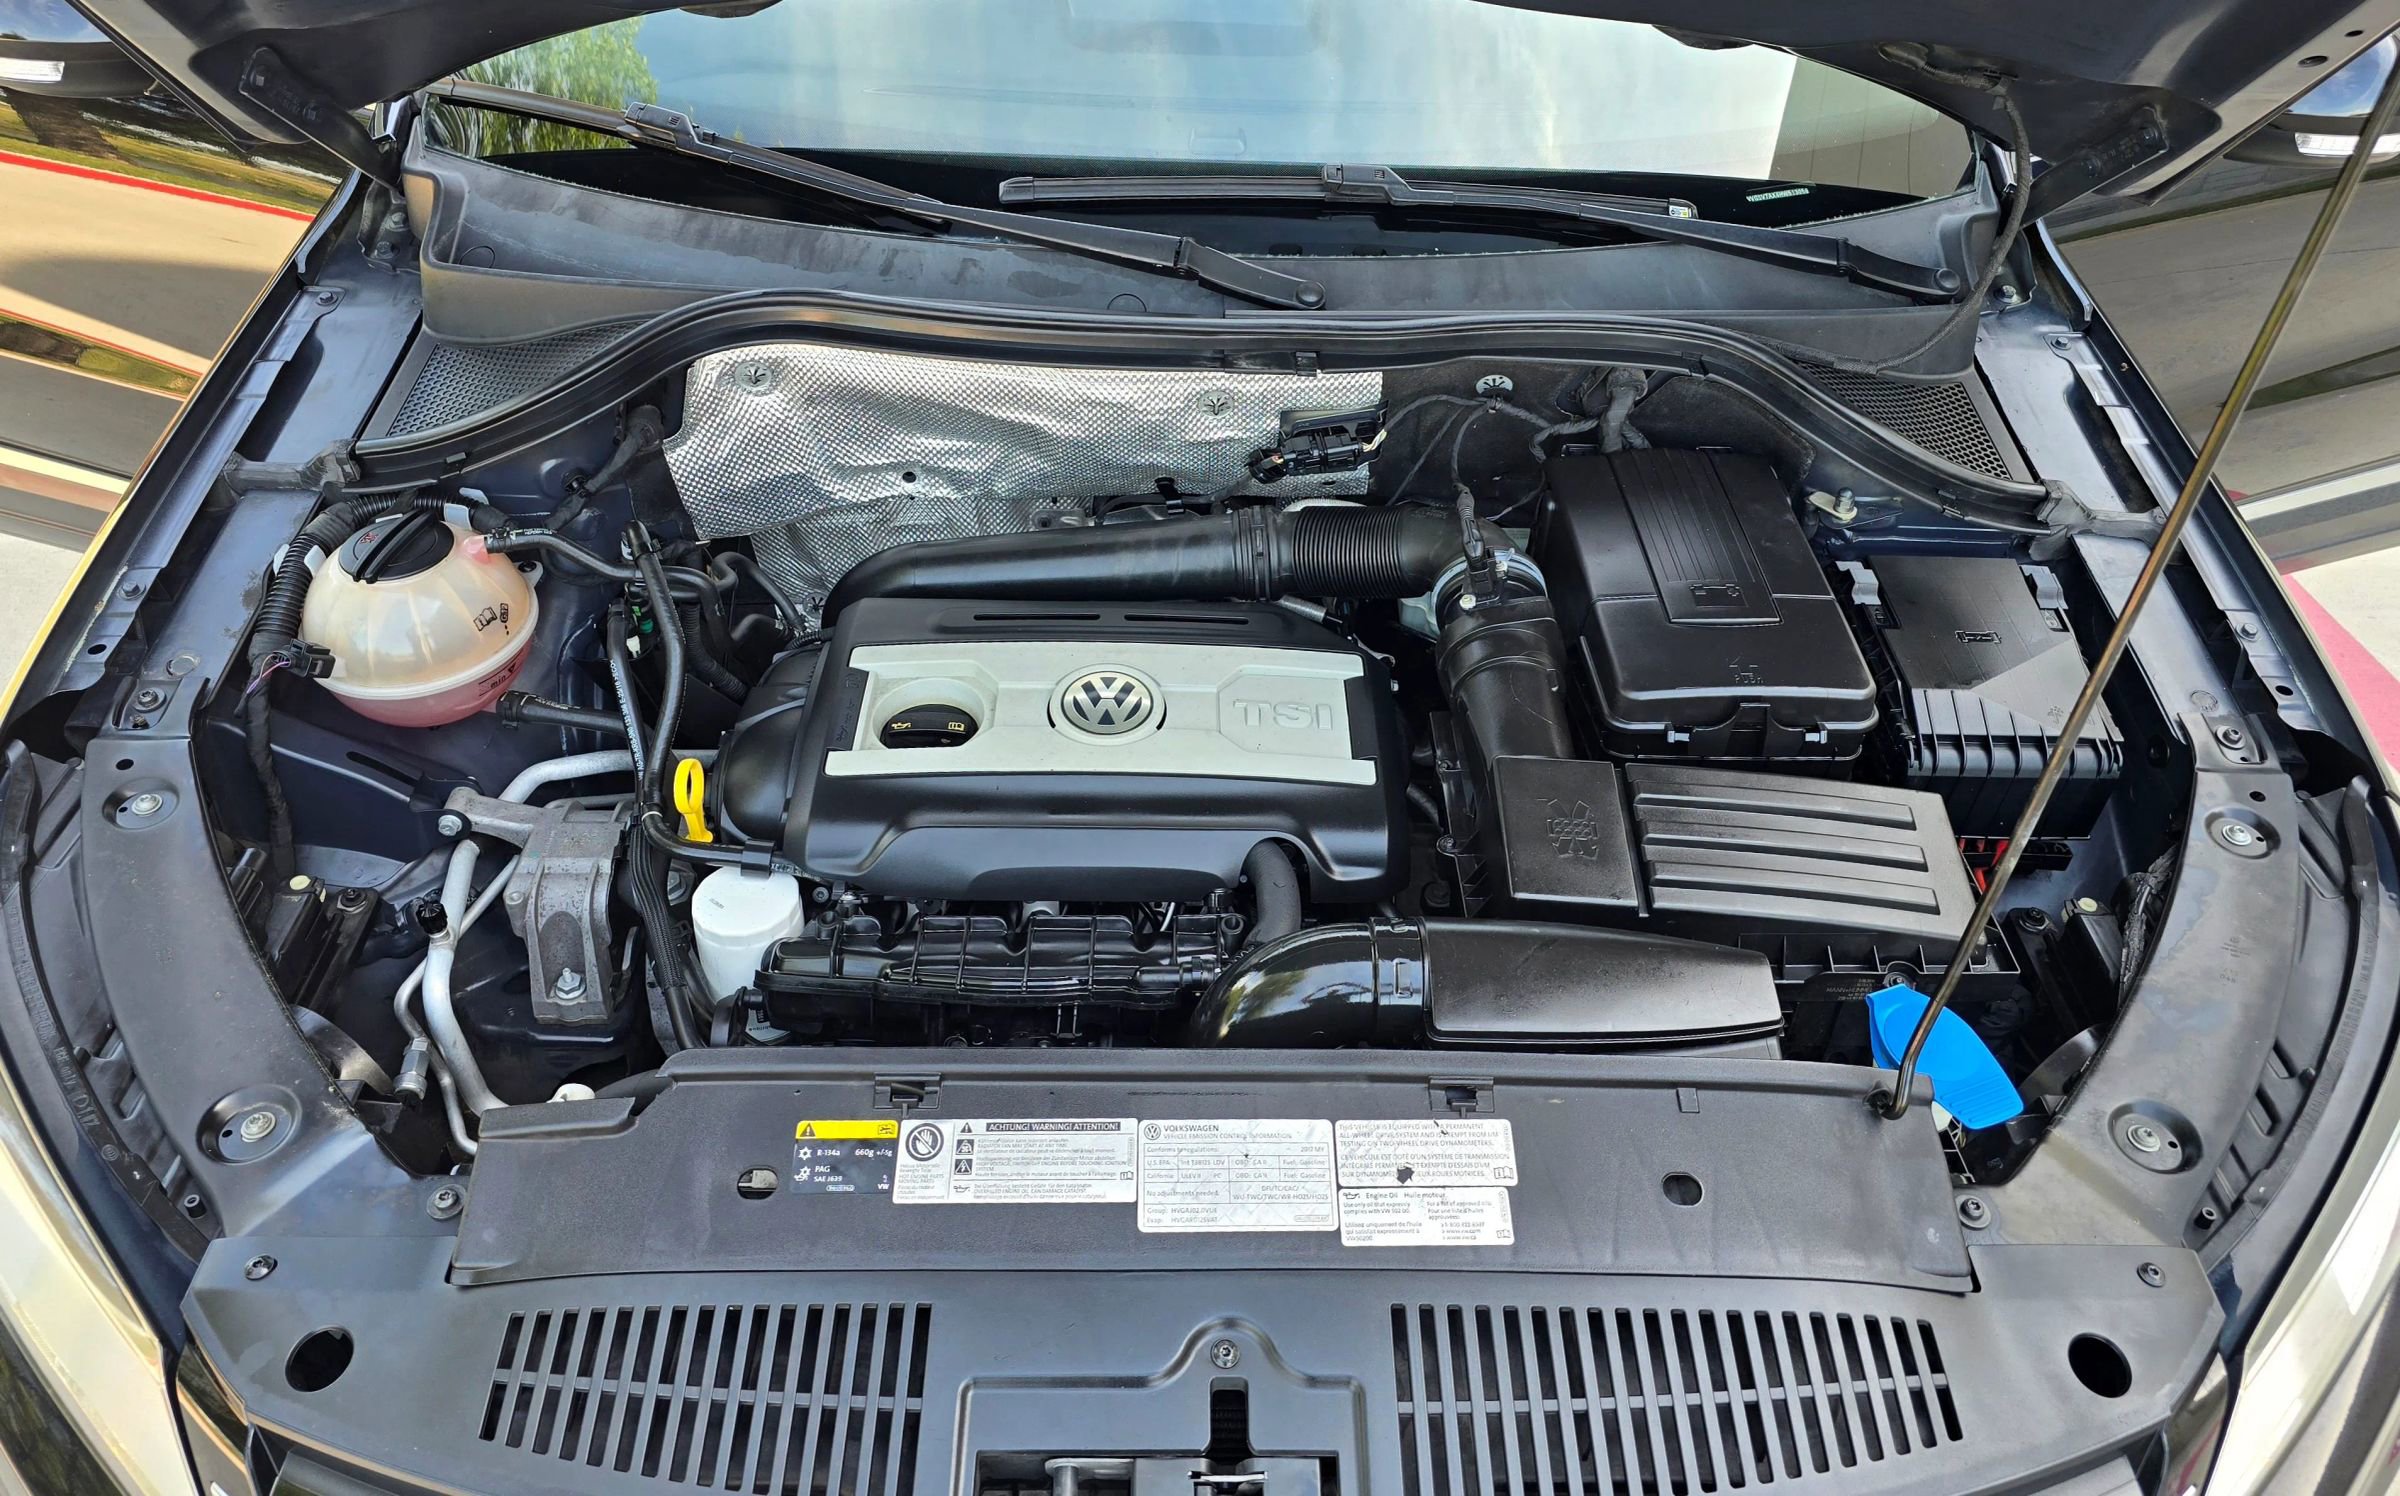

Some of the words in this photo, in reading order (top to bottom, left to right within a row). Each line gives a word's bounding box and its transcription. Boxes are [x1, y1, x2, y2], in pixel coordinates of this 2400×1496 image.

[491, 675, 506, 690] min
[1233, 699, 1333, 731] TSI
[988, 1123, 1030, 1131] ACHTUNG!
[1032, 1123, 1072, 1131] WARNING!
[816, 1148, 840, 1156] R-134a
[855, 1149, 874, 1157] 660g
[1366, 1192, 1388, 1200] Engine
